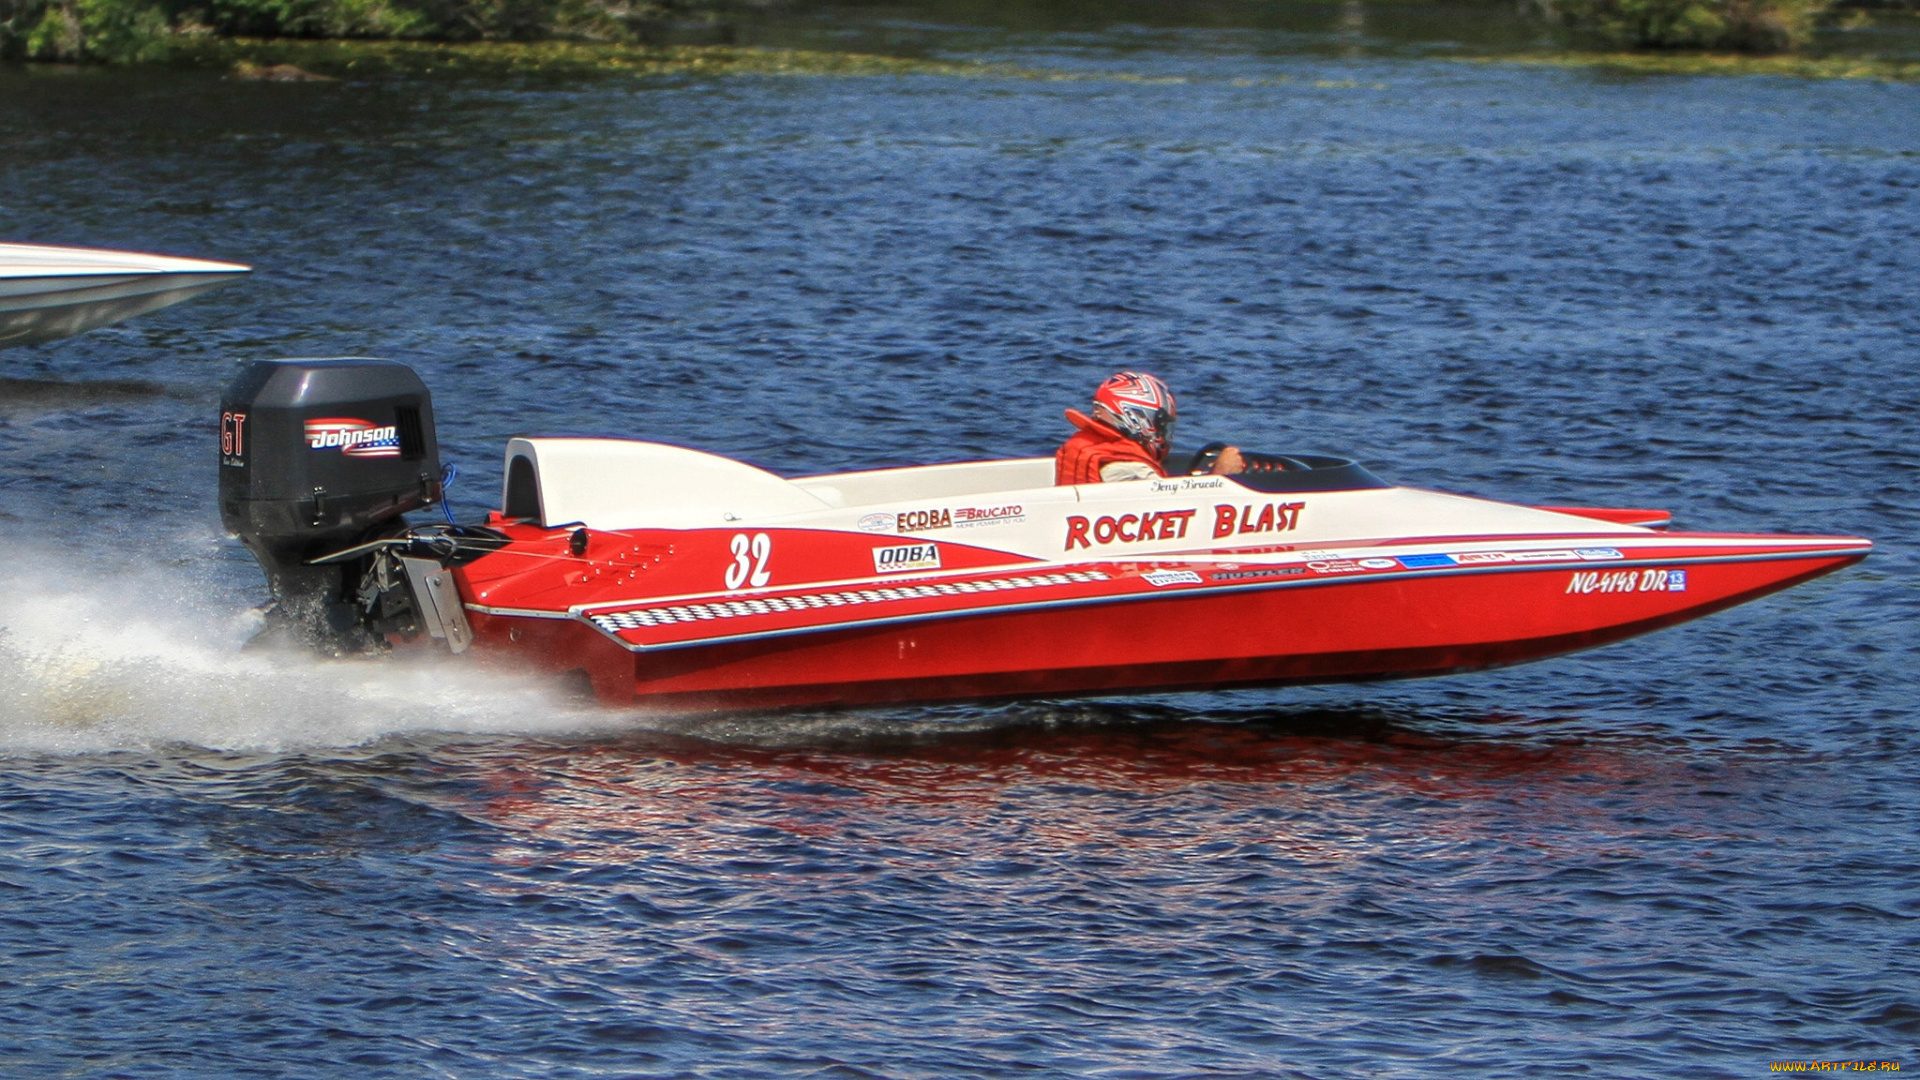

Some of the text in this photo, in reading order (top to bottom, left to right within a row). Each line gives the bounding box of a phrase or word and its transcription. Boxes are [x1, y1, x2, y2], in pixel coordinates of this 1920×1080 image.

[221, 412, 246, 456] GT
[311, 426, 396, 449] Johnson
[897, 508, 952, 530] ECDBA
[966, 505, 1023, 520] BRUCATO
[1065, 502, 1306, 551] ROCKET BLAST
[725, 533, 771, 590] 32
[879, 545, 937, 564] ODBA
[1211, 568, 1305, 580] HUSTLER
[1565, 569, 1668, 594] NC-4148 DR
[1669, 573, 1683, 584] 13
